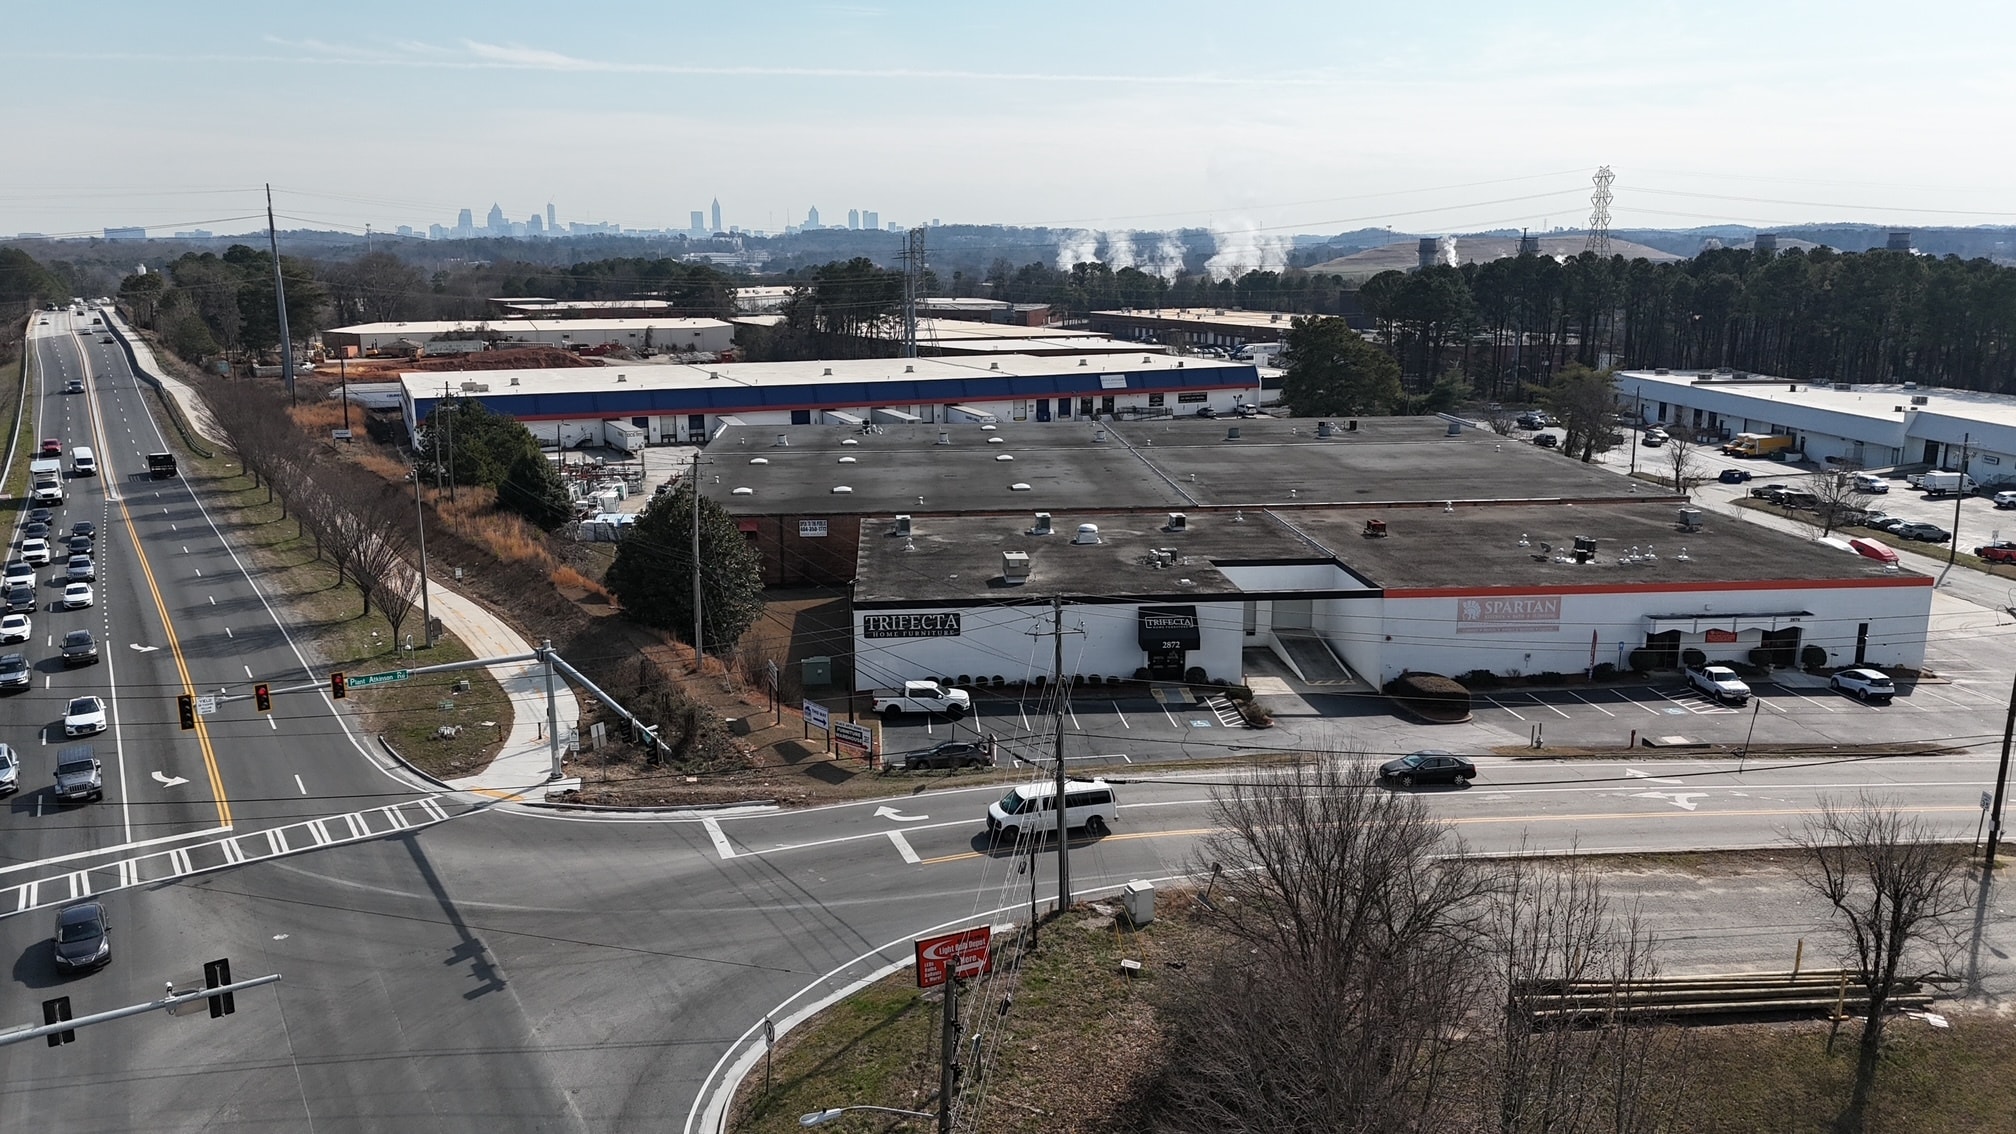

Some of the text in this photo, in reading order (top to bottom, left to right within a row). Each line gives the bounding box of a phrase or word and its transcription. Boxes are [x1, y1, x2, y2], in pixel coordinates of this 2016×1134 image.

[1485, 599, 1557, 615] SPARTAN
[865, 614, 959, 631] TRIFECTA
[1146, 618, 1191, 626] TRIFECTA
[1162, 641, 1181, 649] 2872
[369, 675, 393, 683] Atkinson
[939, 944, 954, 955] Light
[969, 938, 986, 947] Depot
